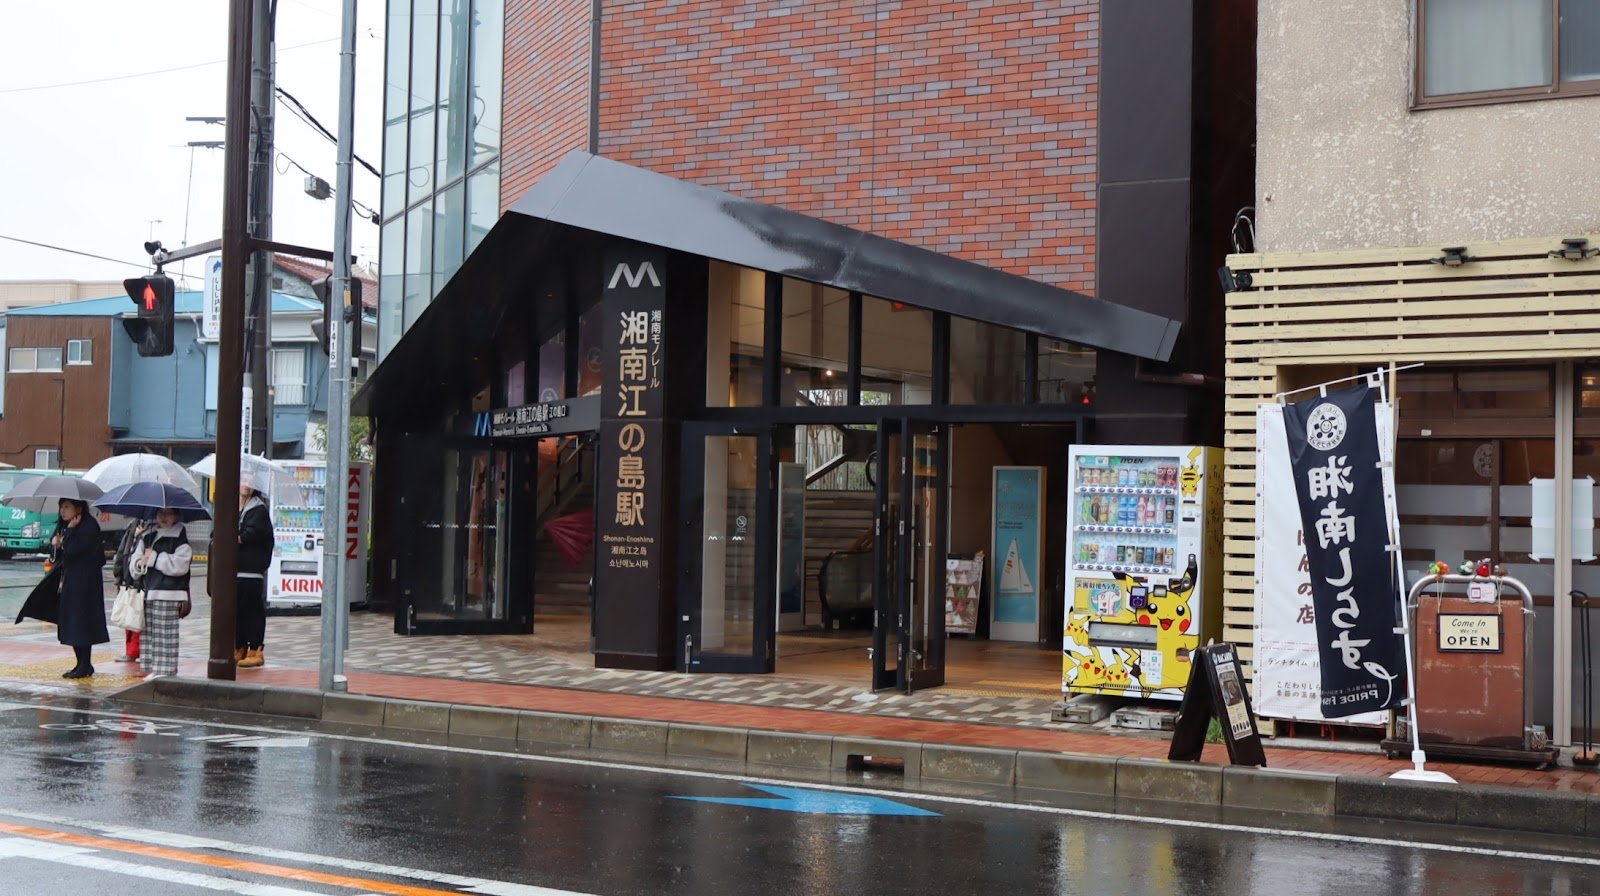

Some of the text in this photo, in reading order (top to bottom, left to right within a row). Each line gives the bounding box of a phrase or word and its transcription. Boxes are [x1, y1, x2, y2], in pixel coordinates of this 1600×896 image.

[650, 309, 662, 388] 湘南モノレール
[516, 404, 548, 424] 湘南江の島駅
[548, 405, 567, 418] 江の島口
[615, 310, 648, 526] 湘南江の島駅
[11, 508, 26, 520] 224
[346, 468, 360, 560] KIRIN
[603, 534, 654, 543] Shonan-Enoshima
[609, 559, 649, 568] 쇼난에노시마
[1452, 618, 1486, 628] Come In
[1447, 636, 1490, 646] OPEN
[1268, 658, 1308, 666] ランチタイム
[1277, 681, 1321, 690] こだわりしら
